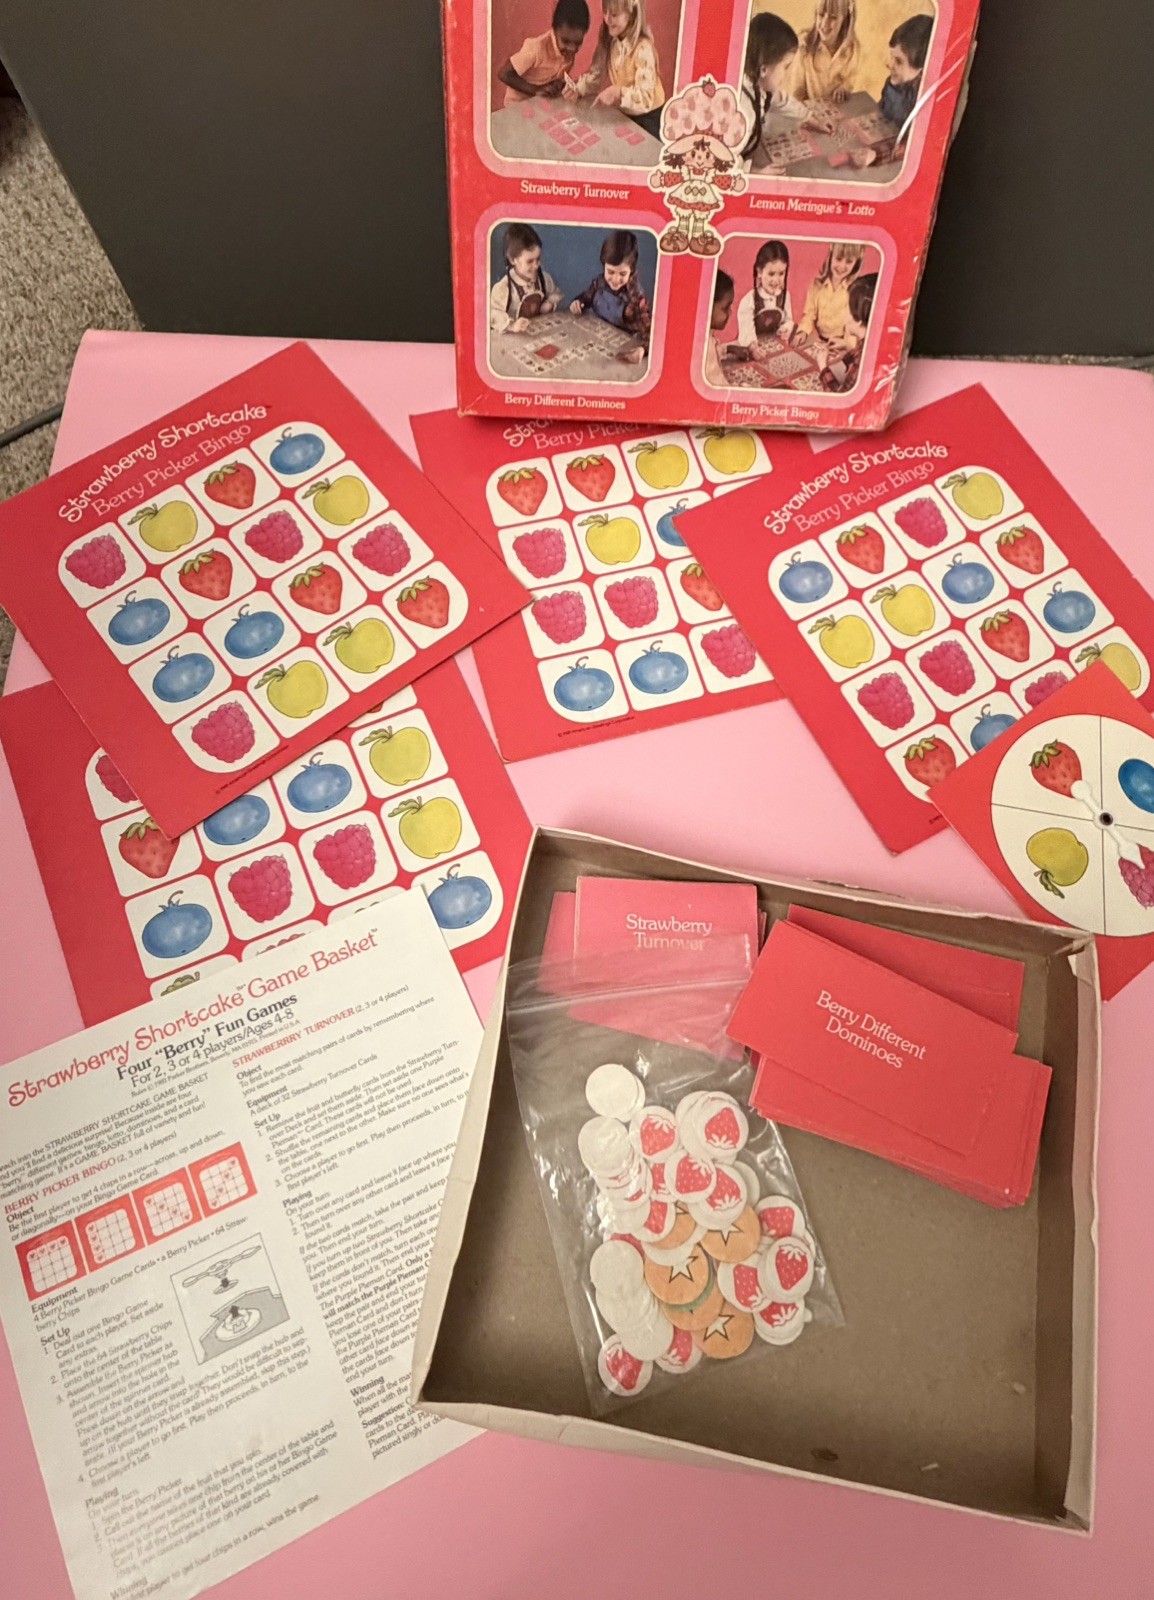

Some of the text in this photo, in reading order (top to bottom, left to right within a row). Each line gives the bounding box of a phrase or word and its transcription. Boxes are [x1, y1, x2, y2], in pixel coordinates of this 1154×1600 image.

[521, 180, 630, 200] Strawberry Turnover
[749, 195, 785, 210] Lemon
[848, 202, 875, 216] Lotto
[504, 393, 626, 410] Berry Different Dominoes
[732, 403, 820, 420] Berry Picker Bingo
[59, 403, 268, 523] Strawberry Shortcake
[532, 429, 584, 450] Berry
[90, 424, 251, 517] Berry Picker Bingo
[763, 441, 948, 535] Strawberry Shortcake
[792, 461, 935, 532] Berry Picker Bingo
[626, 913, 713, 937] Strawberry
[633, 931, 706, 951] Turnover
[3, 1040, 136, 1105] Strawberry
[245, 963, 310, 1000] Game
[303, 1006, 354, 1035] TURNOVER
[384, 983, 409, 1001] players)
[816, 989, 927, 1060] Berry Different
[115, 1057, 154, 1079] Four
[214, 1017, 244, 1036] Fun
[245, 994, 297, 1022] Games
[130, 1007, 294, 1087] For 2, 3 or 4 players/Ages 4-8
[239, 1080, 248, 1088] To
[248, 1073, 262, 1083] find
[262, 1069, 274, 1077] the
[274, 1060, 291, 1072] most
[291, 1048, 322, 1064] matching
[322, 1040, 337, 1052] pairs
[338, 1035, 345, 1043] of
[345, 1029, 363, 1039] cards
[373, 1005, 415, 1027] remembering
[414, 996, 434, 1008] where
[826, 1015, 904, 1069] Dominoes
[235, 1063, 262, 1080] Object
[242, 1086, 255, 1097] you
[270, 1071, 286, 1083] each
[246, 1084, 287, 1108] Equipment
[255, 1101, 272, 1113] deck
[273, 1097, 280, 1105] of
[280, 1092, 290, 1101] 32
[290, 1077, 327, 1097] Strawberry
[327, 1063, 357, 1080] Turnover
[357, 1054, 377, 1066] Cards
[17, 1072, 208, 1163] into the STRAWBERRY SHORTCAKE GAME BASKET
[26, 1159, 57, 1177] different
[163, 1105, 177, 1115] and
[183, 1095, 199, 1106] card
[31, 1154, 46, 1166] find
[51, 1139, 83, 1156] delicious
[114, 1112, 144, 1128] Because
[144, 1102, 165, 1114] inside
[165, 1097, 177, 1105] are
[177, 1090, 192, 1100] four
[74, 1149, 99, 1165] GAME
[100, 1134, 132, 1153] BASKET
[133, 1129, 144, 1138] full
[145, 1124, 153, 1133] of
[153, 1115, 177, 1129] variety
[177, 1107, 191, 1118] and
[191, 1101, 205, 1112] fun!
[253, 1113, 281, 1128] Set Up
[3, 1191, 41, 1214] BERRY
[41, 1173, 80, 1196] PICKER
[81, 1157, 116, 1178] BINGO
[149, 1130, 177, 1149] players)
[282, 1190, 312, 1207] Playing
[6, 1204, 34, 1223] Object
[30, 1284, 77, 1313] Equipment
[33, 1314, 39, 1322] 4
[40, 1305, 61, 1319] Berry
[62, 1293, 86, 1308] Picker
[86, 1282, 109, 1296] Bingo
[109, 1271, 133, 1285] Game
[166, 1244, 188, 1258] Berry
[187, 1234, 210, 1248] Picker
[320, 1299, 333, 1310] The
[333, 1287, 357, 1302] Purple
[357, 1274, 384, 1290] Pieman
[404, 1254, 423, 1266] Only
[322, 1264, 423, 1319] will match the Purple Pieman
[40, 1327, 70, 1345] Set Up
[57, 1306, 79, 1320] Chips
[350, 1376, 384, 1396] Winning
